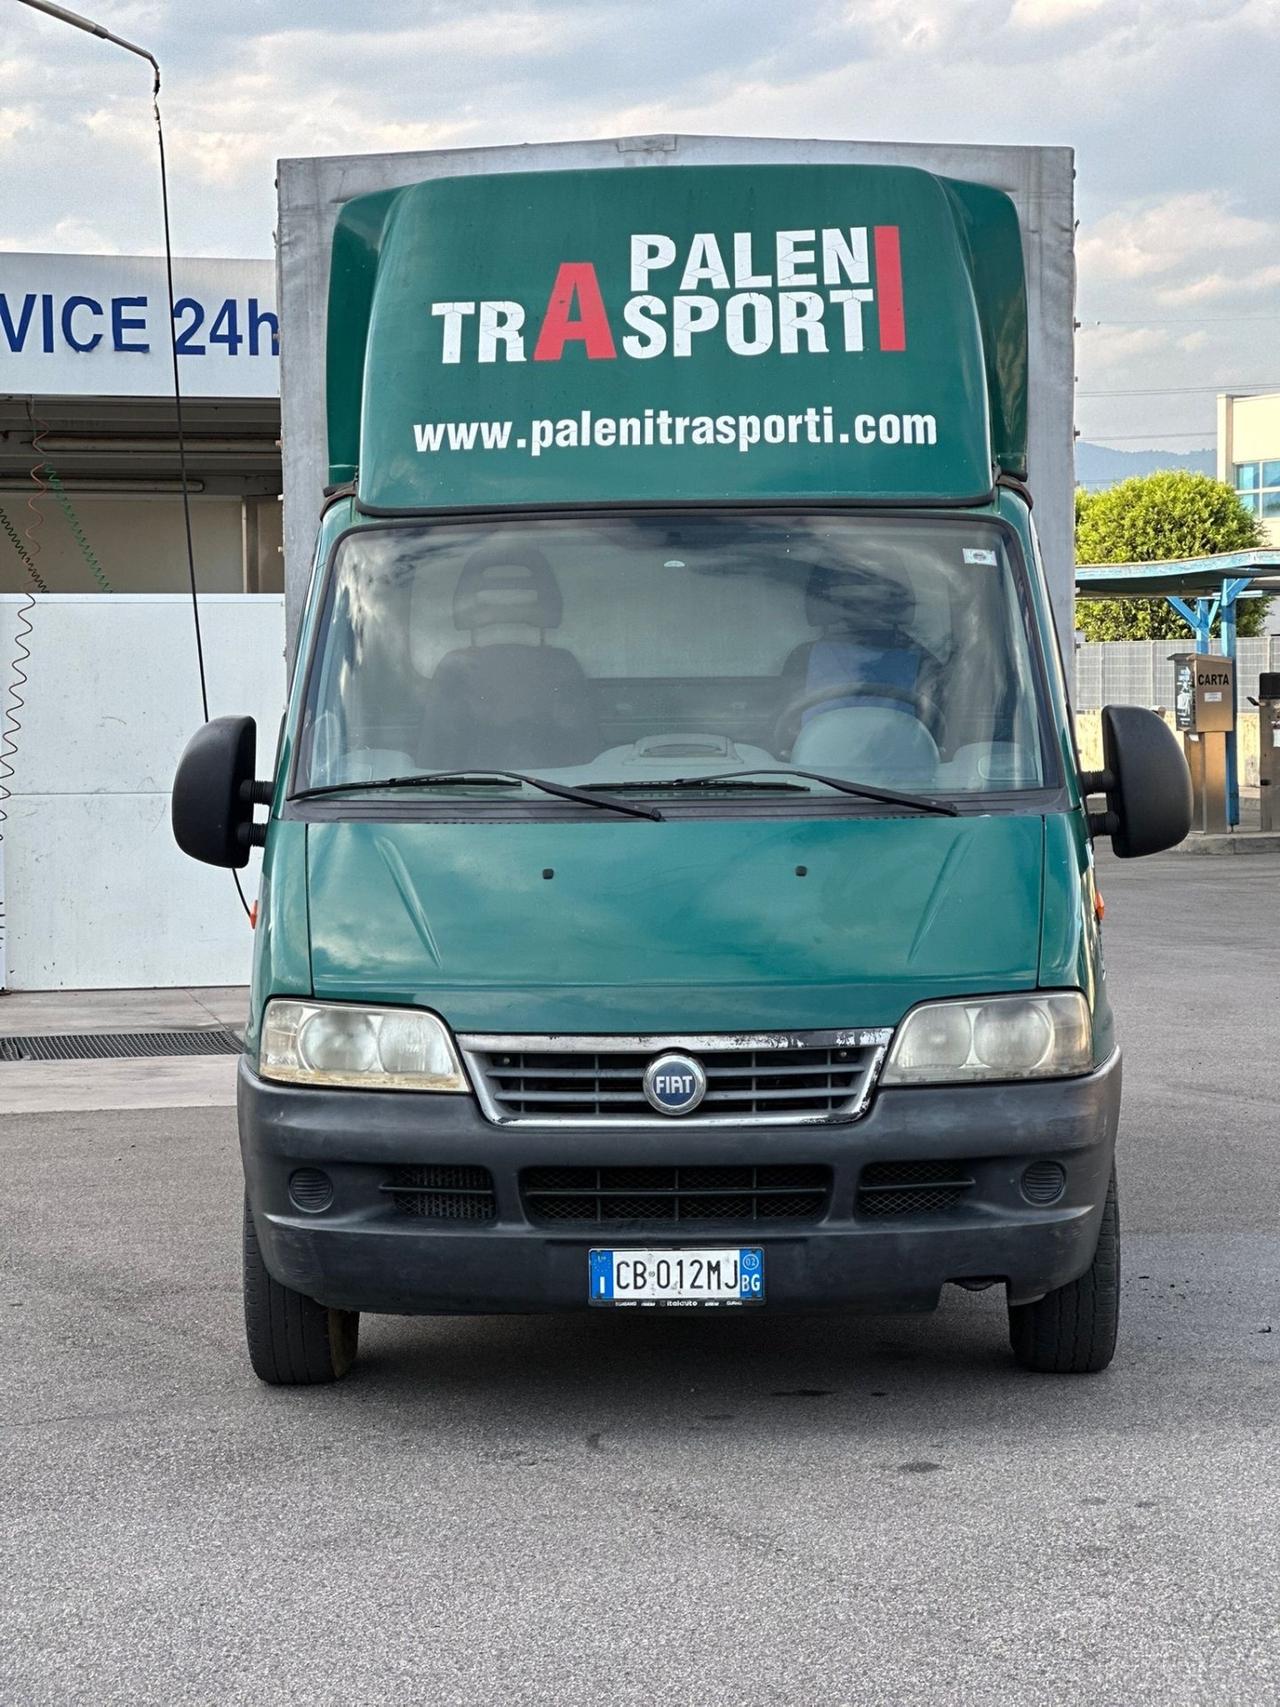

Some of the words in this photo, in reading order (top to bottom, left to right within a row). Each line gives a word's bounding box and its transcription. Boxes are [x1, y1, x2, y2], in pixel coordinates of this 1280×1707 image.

[173, 297, 280, 356] 24h
[413, 406, 938, 456] www.palenitrasporti.com
[1198, 674, 1229, 685] CARTA
[655, 1075, 693, 1094] FIAT
[741, 1274, 761, 1292] BG
